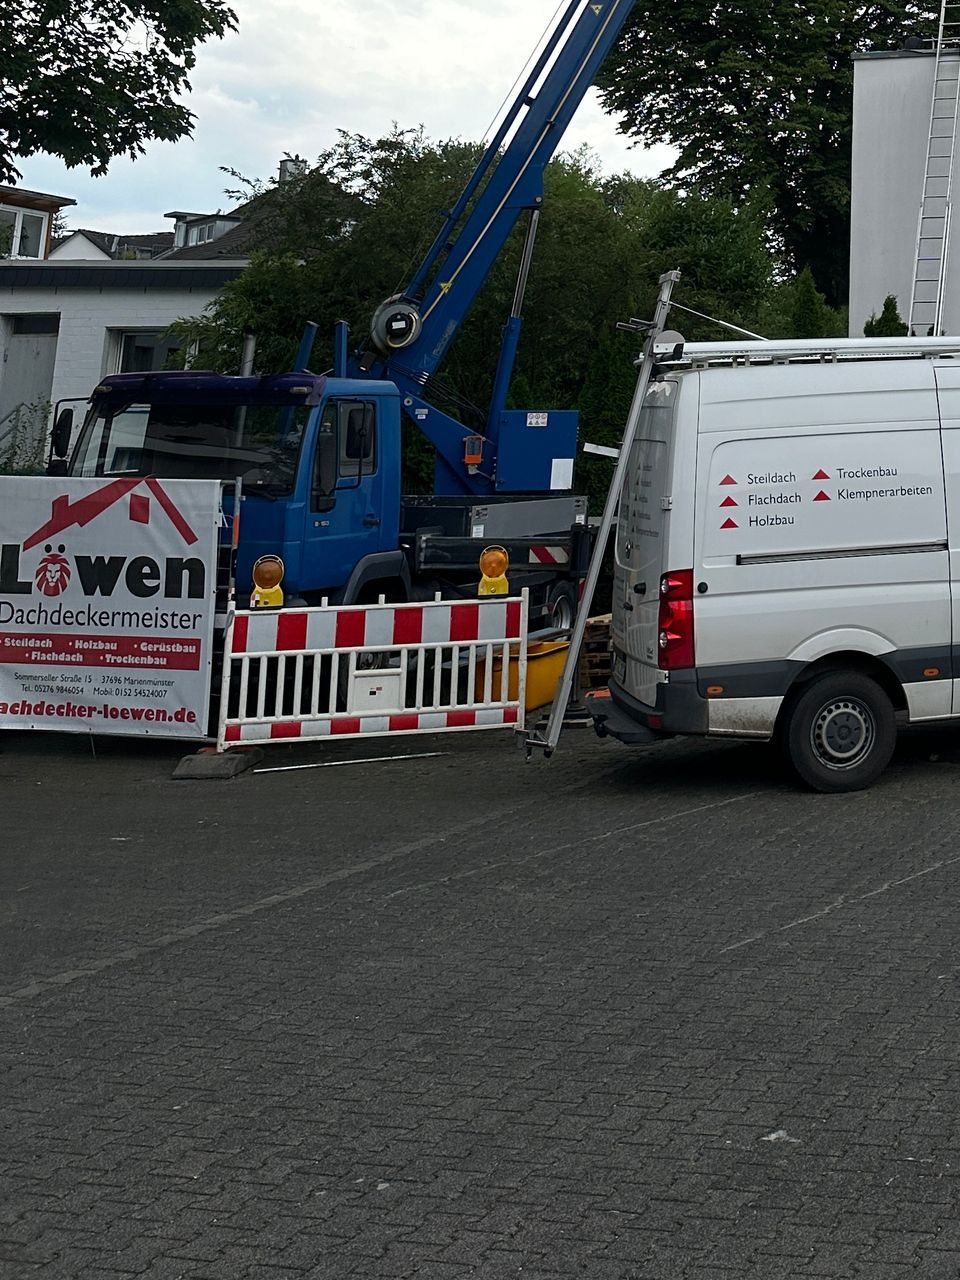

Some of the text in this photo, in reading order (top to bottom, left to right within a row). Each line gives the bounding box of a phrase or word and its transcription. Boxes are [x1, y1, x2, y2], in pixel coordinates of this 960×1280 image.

[747, 472, 797, 485] Steildach
[836, 466, 898, 480] Trockenbau
[748, 492, 802, 506] Flachdach
[837, 485, 933, 501] Klempnerarbeiten
[749, 515, 795, 527] Holzbau
[0, 543, 206, 600] Löwen
[0, 600, 202, 630] Dachdeckermeister
[4, 637, 197, 654] Steildach Holzbau Gerüstbau
[31, 651, 168, 666] Flachdach Trockenbau
[84, 674, 92, 684] 15
[101, 675, 122, 685] 37696
[34, 685, 55, 694] 05276
[115, 688, 132, 697] 0152
[133, 689, 168, 698] 54524007
